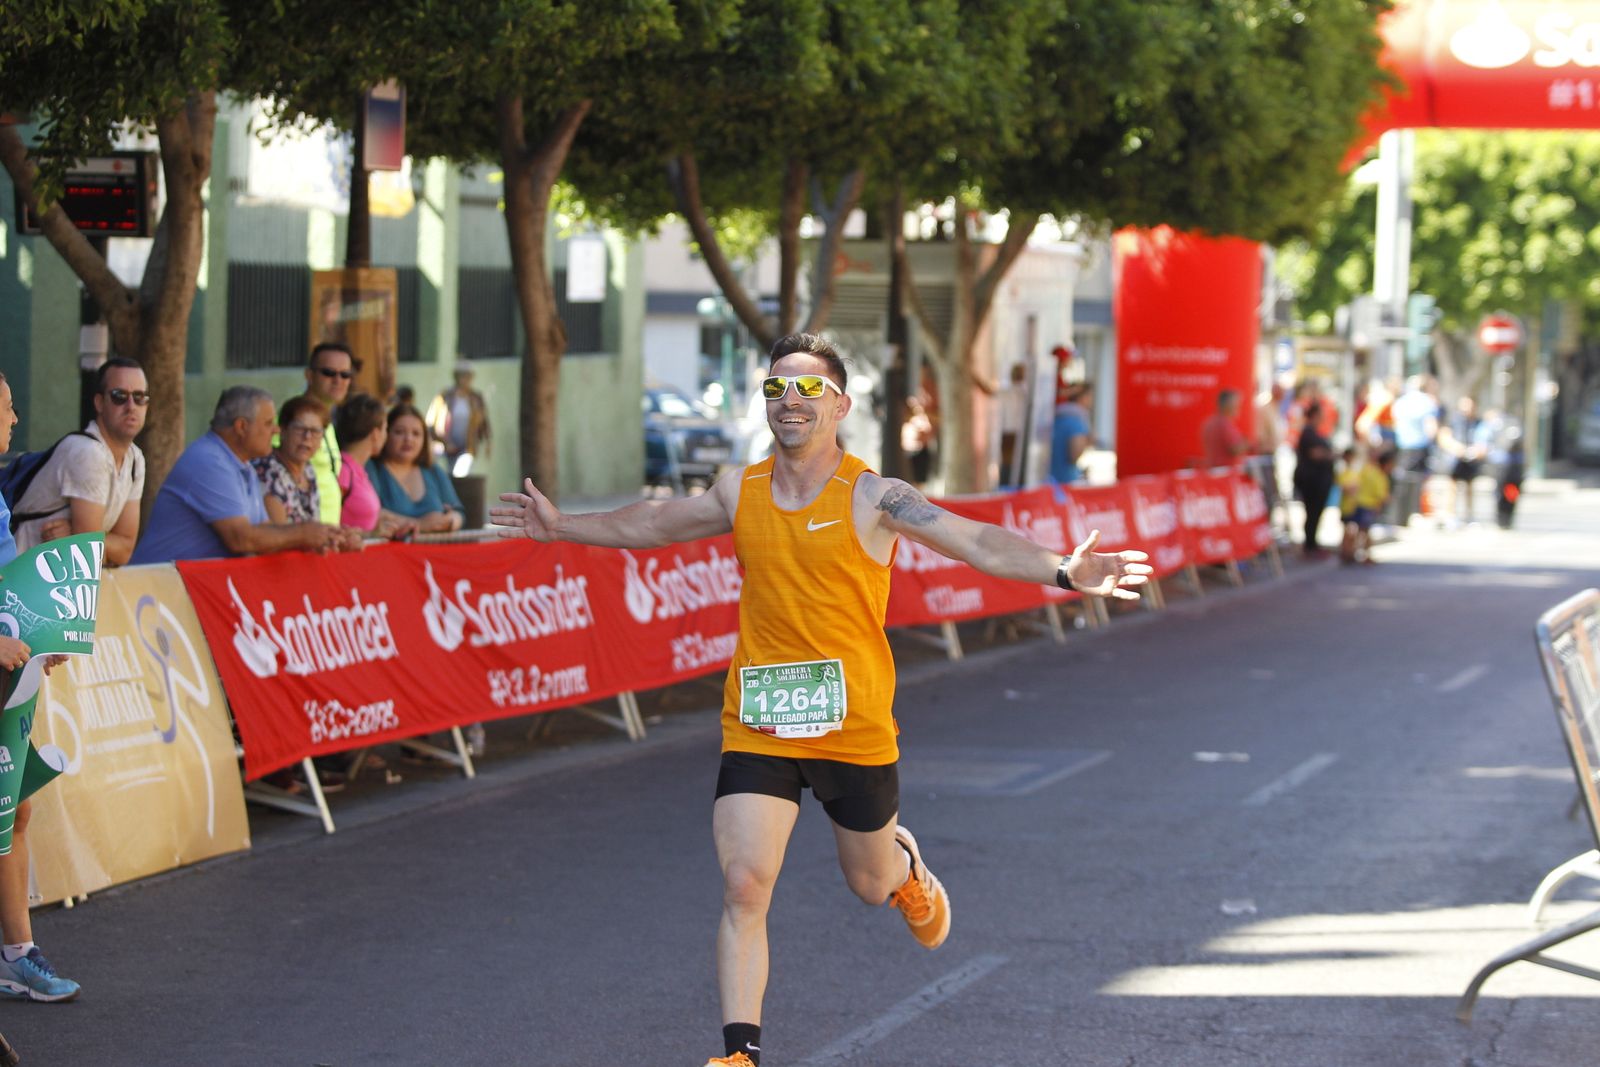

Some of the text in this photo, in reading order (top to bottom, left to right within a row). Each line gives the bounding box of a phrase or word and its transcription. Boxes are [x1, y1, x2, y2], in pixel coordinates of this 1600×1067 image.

[455, 563, 594, 647] Santander
[643, 545, 743, 619] Santande
[263, 587, 399, 676] Santander
[775, 666, 812, 676] CARRERA
[754, 685, 829, 713] 1264
[760, 708, 828, 724] HA LLEGADO PAPÁ
